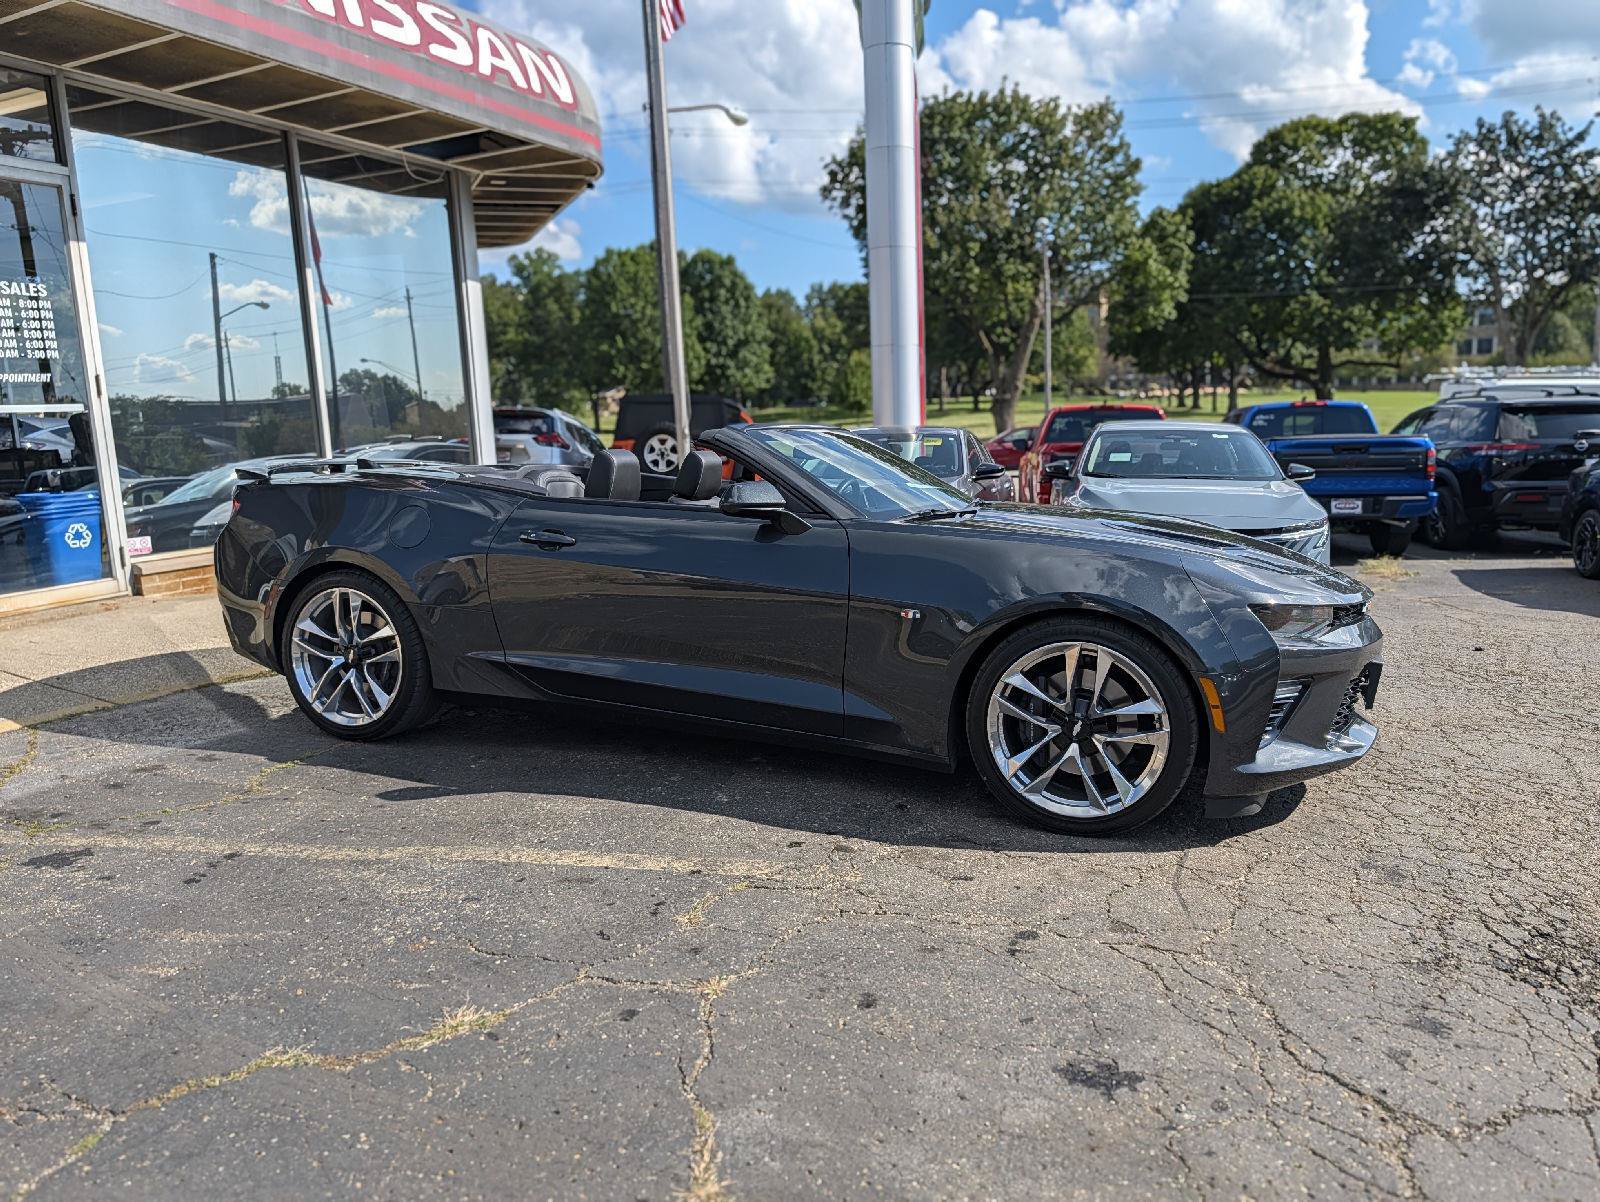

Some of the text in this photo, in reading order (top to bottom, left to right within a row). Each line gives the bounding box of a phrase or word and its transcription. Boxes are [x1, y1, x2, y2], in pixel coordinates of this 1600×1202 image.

[305, 0, 574, 104] SSAN
[0, 280, 47, 297] SALES
[18, 298, 38, 309] 8:00
[38, 299, 52, 310] PM
[0, 307, 13, 318] AM
[20, 309, 40, 319] 6:00
[40, 309, 54, 320] PM
[0, 318, 14, 328] AM
[21, 319, 41, 329] 6:00
[41, 320, 56, 330] PM
[1, 328, 16, 338] AM
[23, 329, 43, 339] 8:00
[43, 330, 57, 340] PM
[3, 338, 18, 349] AM
[25, 339, 44, 349] 6:00
[44, 340, 58, 350] PM
[5, 348, 20, 359] AM
[46, 349, 60, 360] PM
